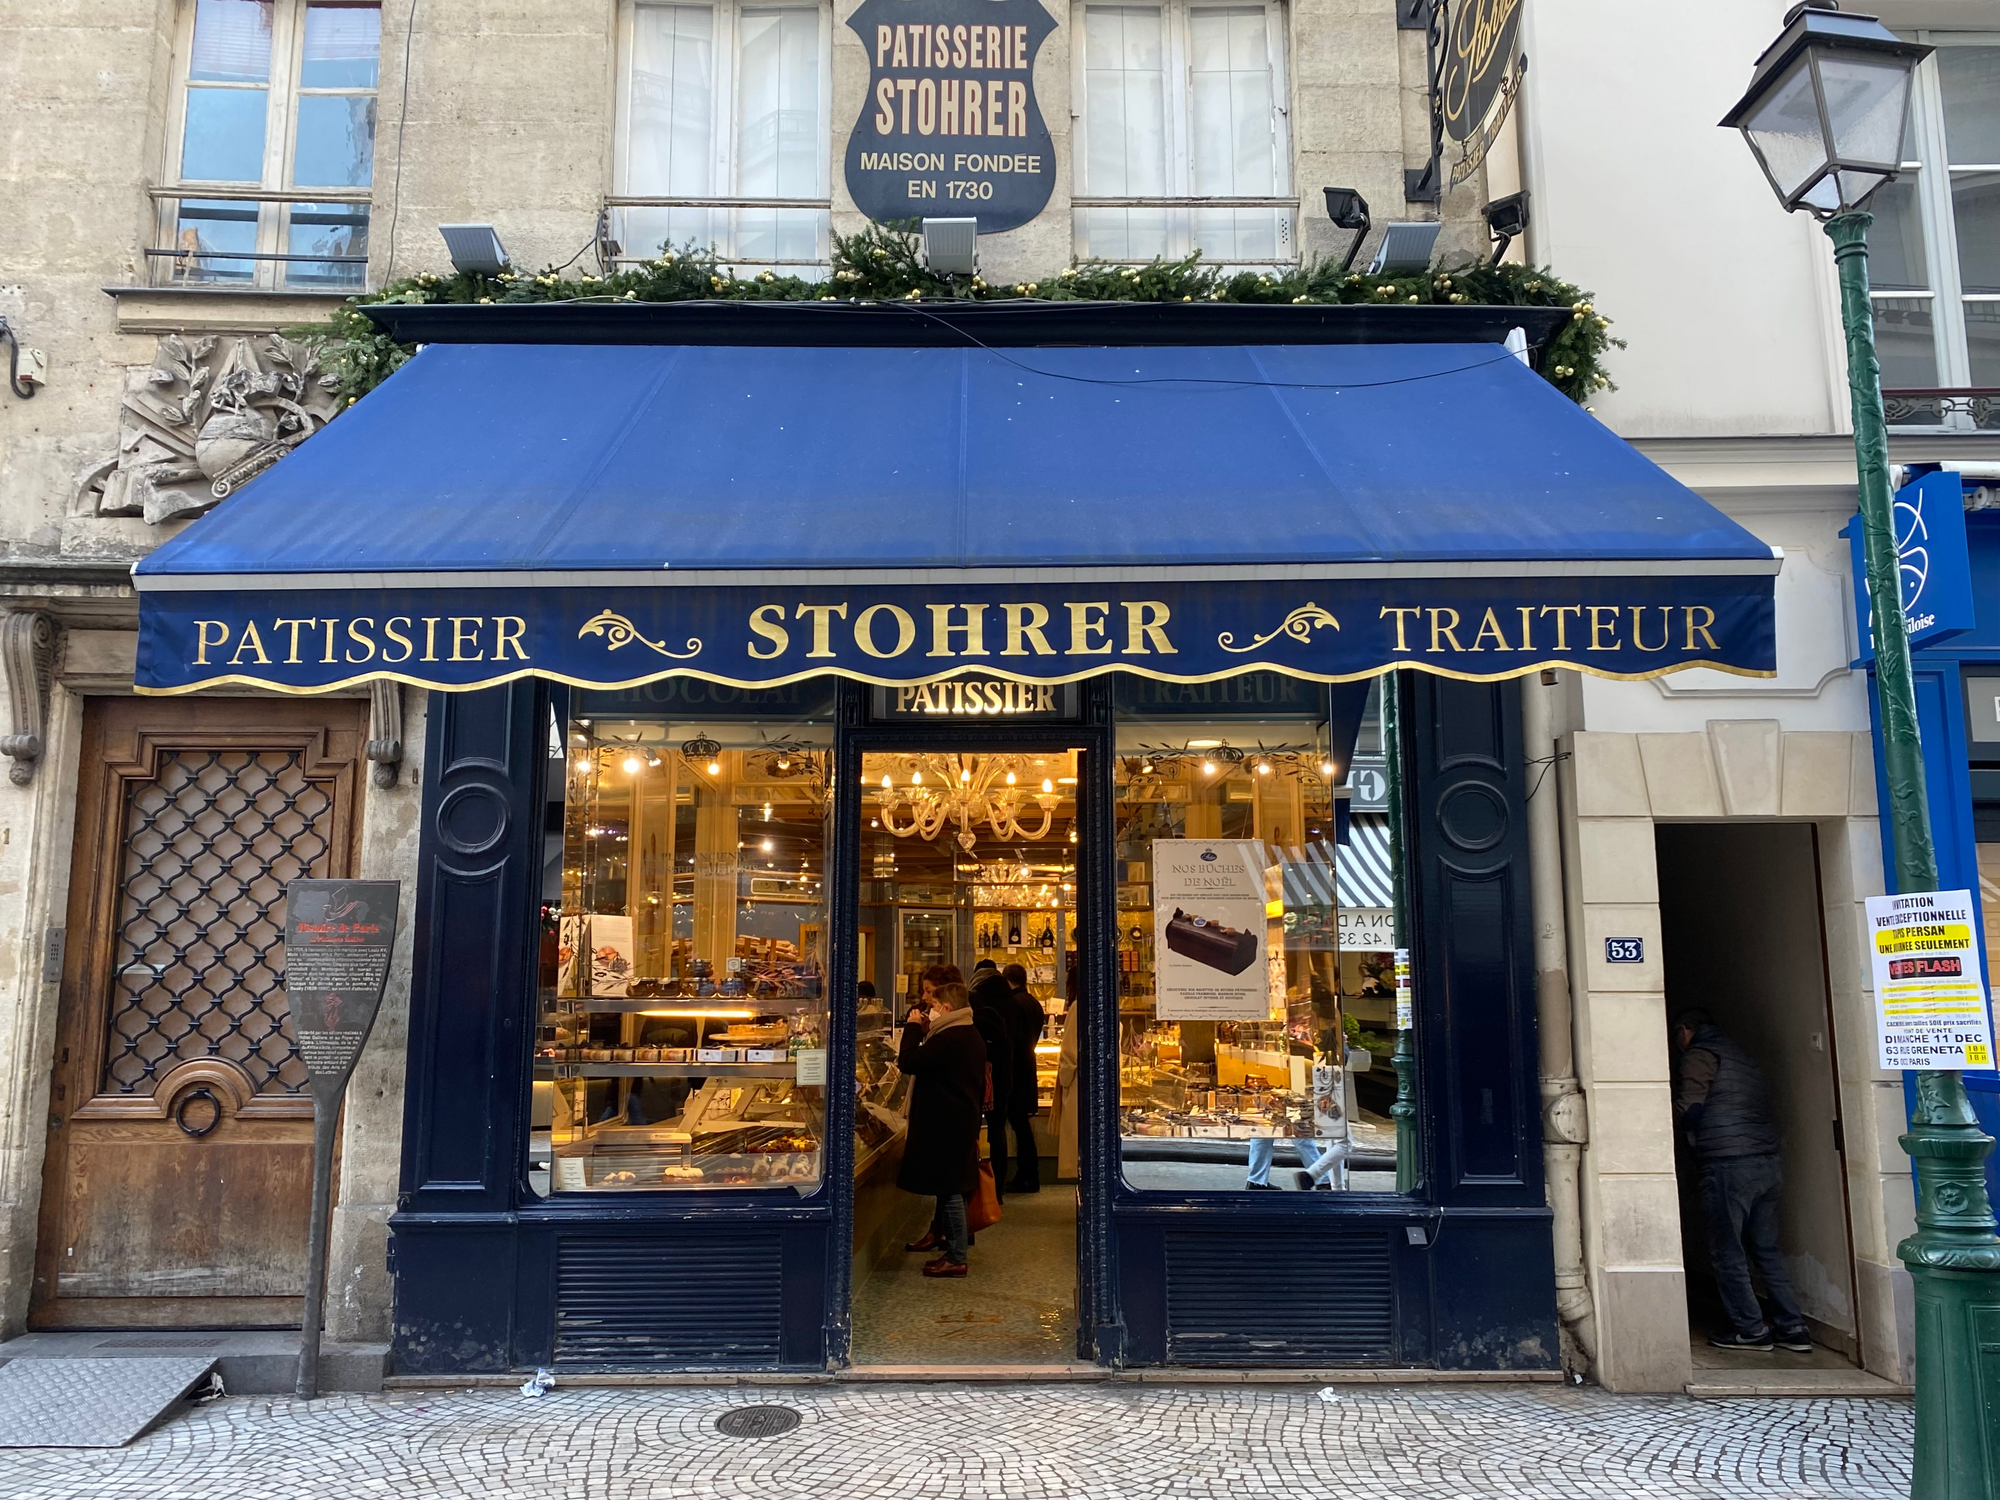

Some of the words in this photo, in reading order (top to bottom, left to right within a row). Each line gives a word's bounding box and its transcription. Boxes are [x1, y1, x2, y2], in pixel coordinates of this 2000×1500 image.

[877, 24, 1028, 69] PATISSERIE
[875, 77, 1027, 137] STOHRER
[860, 152, 945, 172] MAISON
[908, 180, 936, 199] EN
[945, 181, 994, 200] 1730
[747, 600, 1179, 660] STOHRER
[1379, 603, 1722, 654] TRAITEUR
[192, 615, 530, 666] PATISSIER
[896, 682, 1057, 715] PATISSIER
[1172, 865, 1196, 873] NOS
[1184, 878, 1200, 887] DE
[1906, 925, 1946, 938] PERSAN
[1611, 941, 1637, 958] 53
[1914, 938, 1970, 950] SEULEMENT
[1916, 959, 1961, 973] FLASH
[1885, 1034, 1930, 1044] DIMANCHE
[1934, 1034, 1949, 1043] 11
[1955, 1034, 1983, 1043] DEC
[1886, 1046, 1899, 1055] 63
[1911, 1045, 1964, 1055] GRENETA
[1909, 1058, 1931, 1066] PARIS
